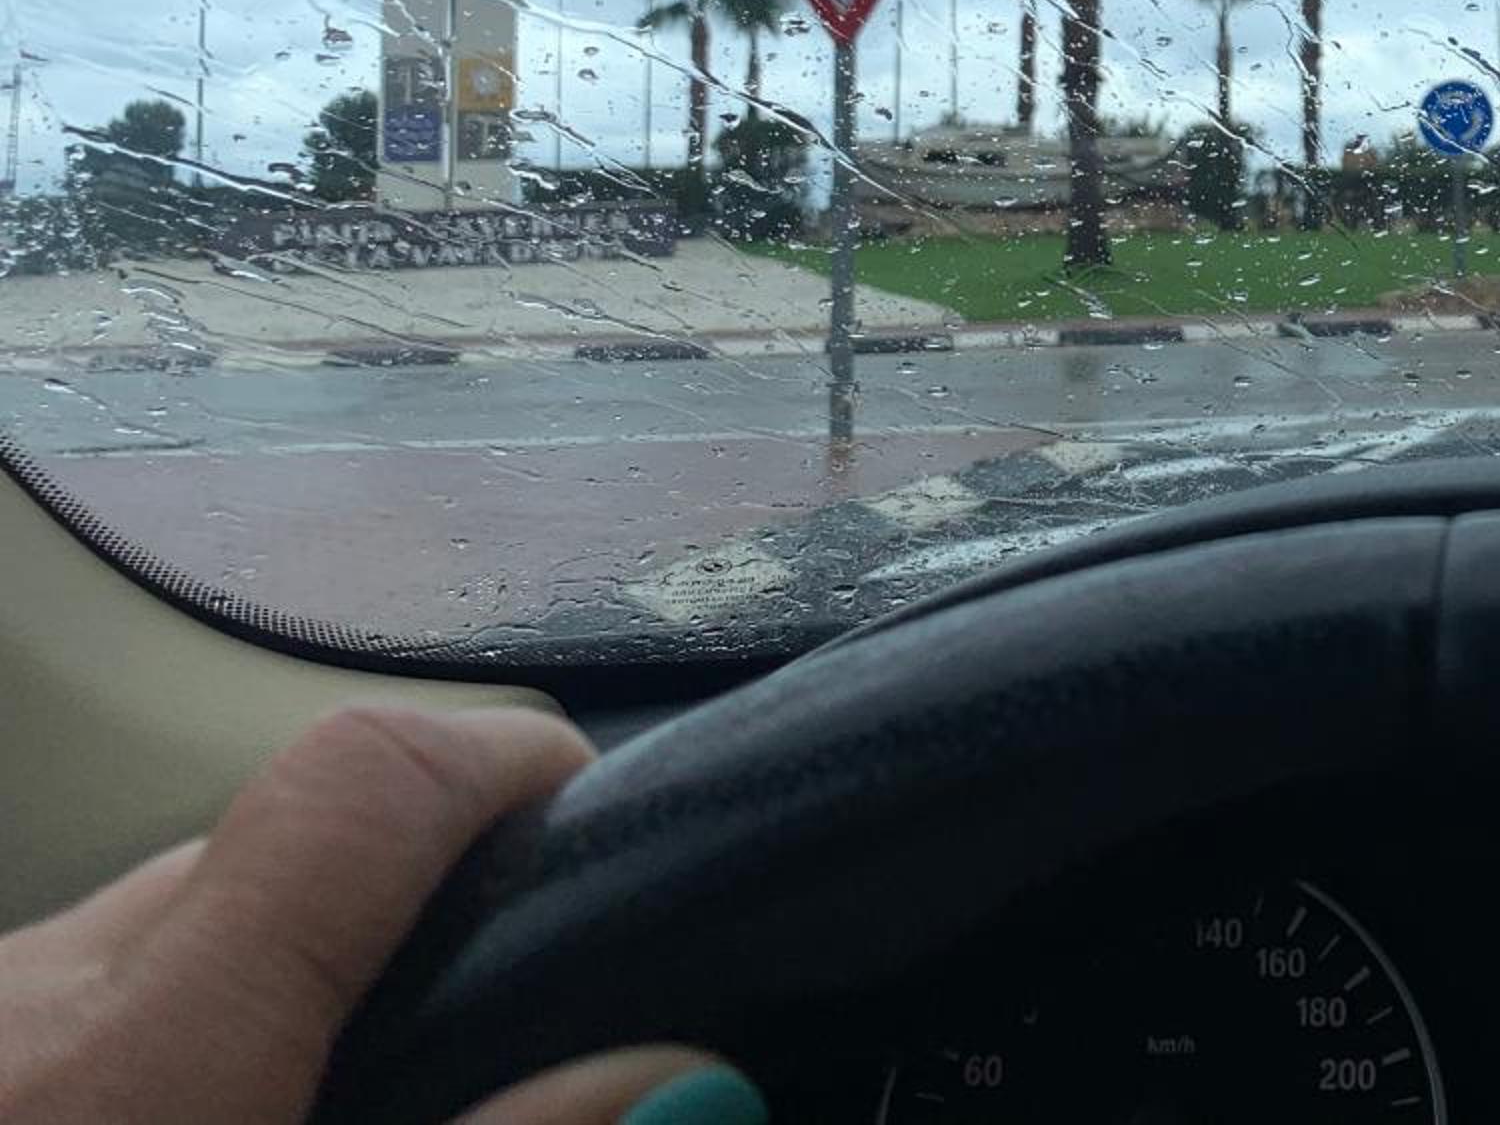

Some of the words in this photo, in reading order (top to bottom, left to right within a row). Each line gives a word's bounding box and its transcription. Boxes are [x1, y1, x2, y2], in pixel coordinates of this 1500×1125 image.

[1194, 916, 1243, 949] 140
[1255, 946, 1306, 978] 160
[1296, 996, 1347, 1028] 180
[1146, 1034, 1196, 1054] km/h
[963, 1054, 1004, 1088] 60
[1318, 1058, 1377, 1091] 200
